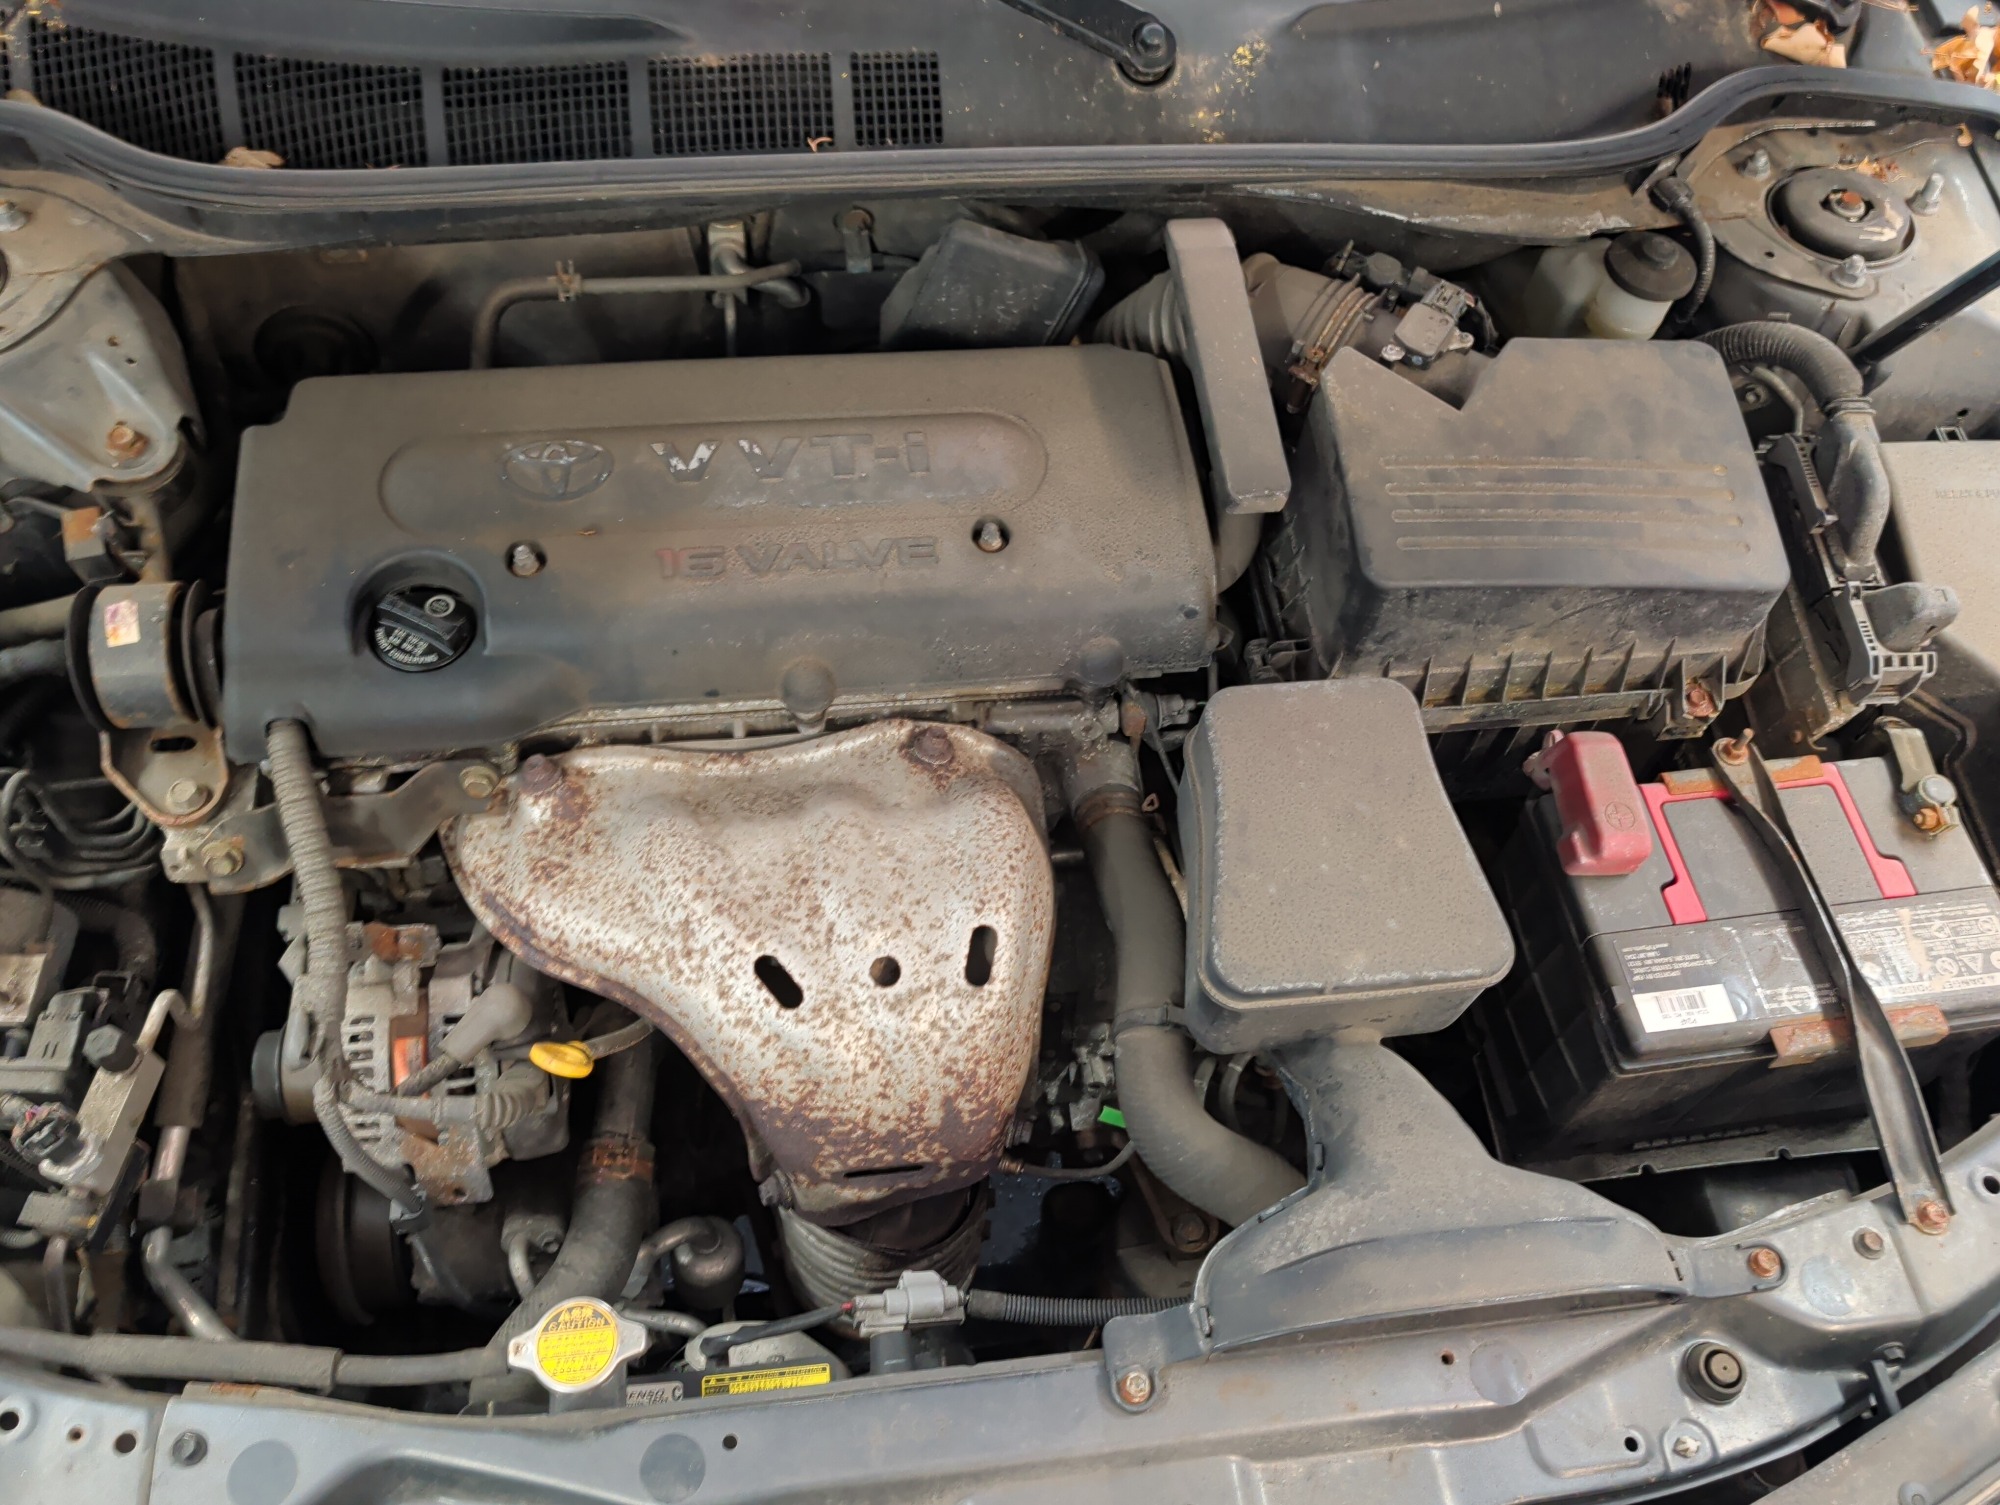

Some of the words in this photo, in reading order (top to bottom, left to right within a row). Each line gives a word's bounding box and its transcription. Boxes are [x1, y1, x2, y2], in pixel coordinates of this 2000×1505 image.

[650, 430, 932, 484] VVT-i
[656, 545, 727, 583] 16
[734, 536, 940, 577] VALVE
[1942, 977, 1988, 990] DANGE
[548, 1317, 605, 1333] CAUTION
[627, 1388, 665, 1399] ENSO
